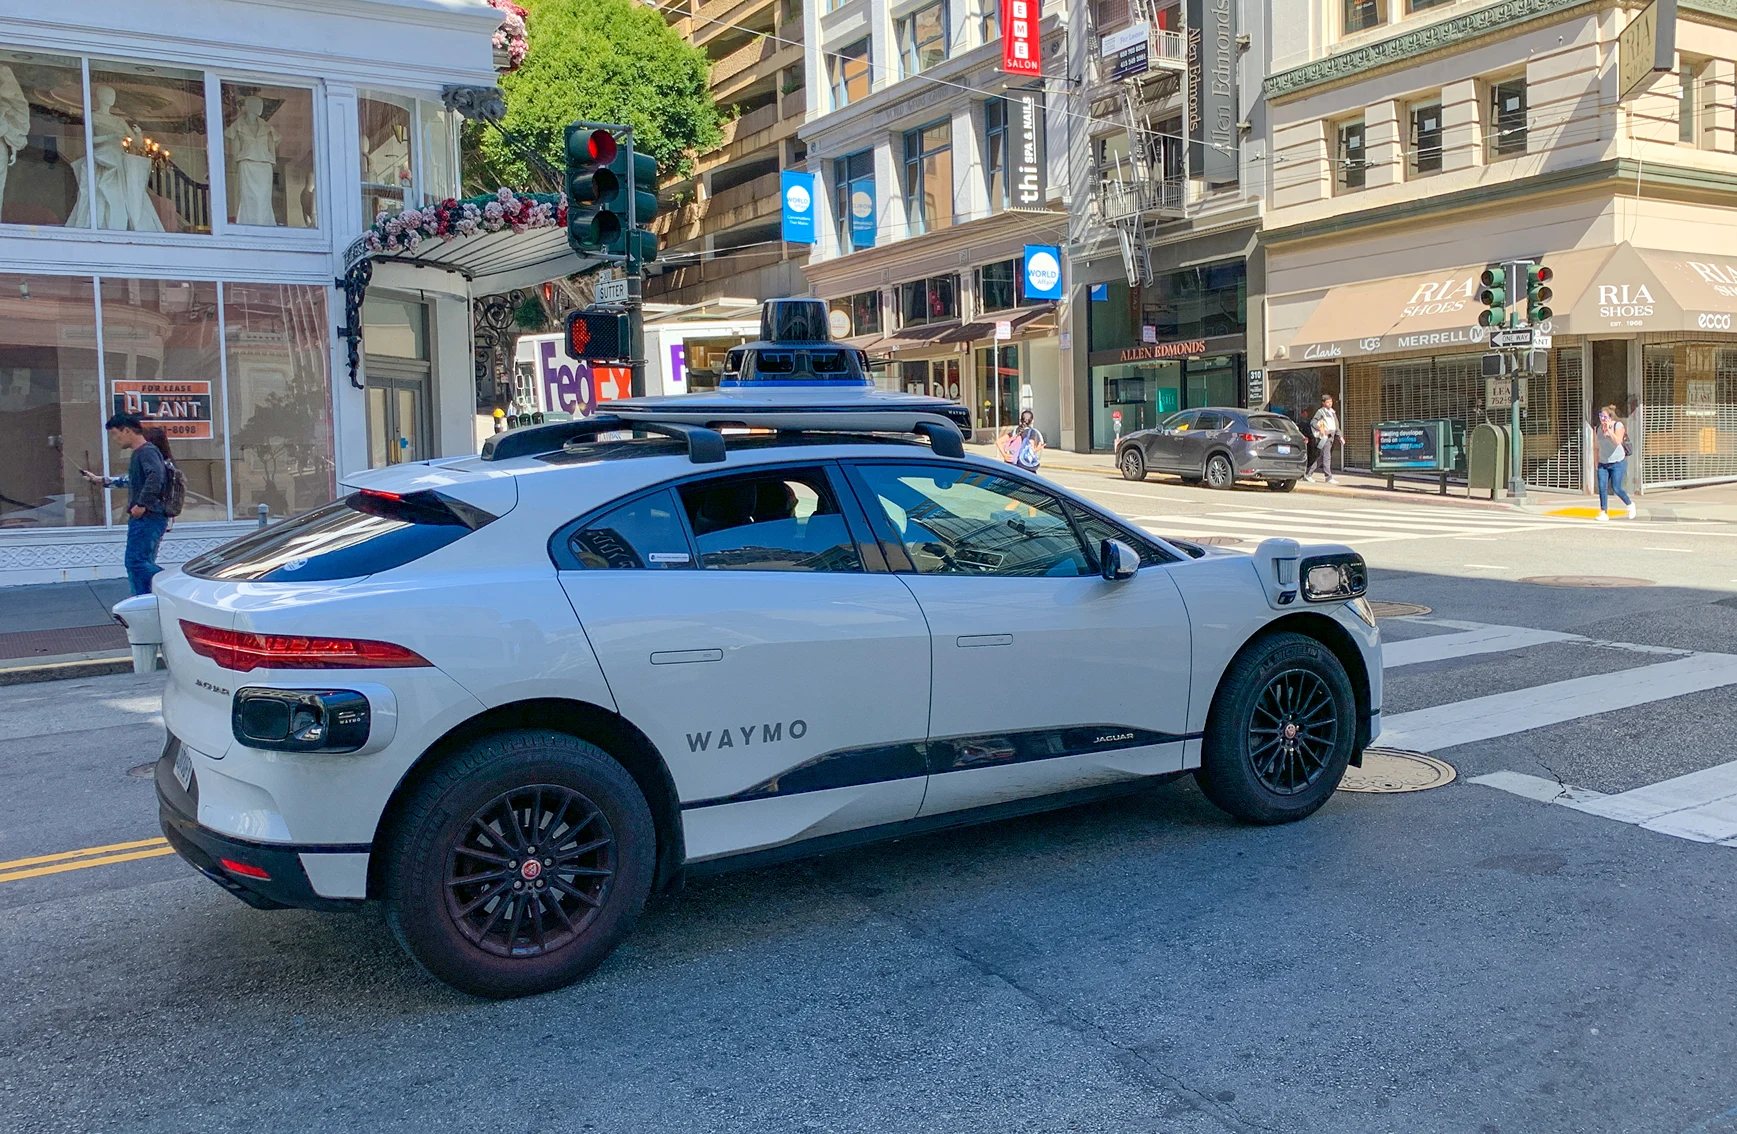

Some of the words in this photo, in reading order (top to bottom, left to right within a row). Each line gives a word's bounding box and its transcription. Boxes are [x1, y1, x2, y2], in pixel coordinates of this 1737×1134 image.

[1188, 27, 1201, 62] Allen
[1210, 0, 1231, 98] Edmonds
[1007, 59, 1038, 70] SALON
[1188, 62, 1201, 132] Edmonds
[1022, 96, 1033, 129] NAILS
[1023, 131, 1033, 140] &
[1211, 104, 1231, 159] Allen
[1024, 142, 1034, 164] SPA
[1018, 166, 1039, 204] thi
[788, 197, 809, 205] WORLD
[1029, 269, 1057, 279] WORLD
[600, 284, 624, 300] SUTTER
[1407, 276, 1473, 305] RIA
[1598, 283, 1656, 305] RIA
[1400, 300, 1467, 318] SHOES
[1600, 305, 1654, 318] SHOES
[1698, 313, 1731, 330] ecco
[1360, 338, 1380, 351] UGG
[1398, 333, 1467, 348] MERRELL
[1502, 334, 1514, 342] ONE
[1515, 332, 1529, 341] WAY
[1534, 338, 1549, 346] ANT
[1120, 346, 1152, 361] ALLEN
[1154, 340, 1206, 358] EDMONDS
[1304, 343, 1342, 360] Clarks
[1250, 370, 1261, 380] 310
[141, 384, 161, 392] FOR
[164, 384, 192, 392] LEASE
[124, 390, 201, 418] PLANT
[1161, 395, 1175, 405] SALE
[339, 717, 362, 725] WAYMO
[686, 720, 807, 753] WAYMO
[1093, 733, 1134, 744] JAGUAR
